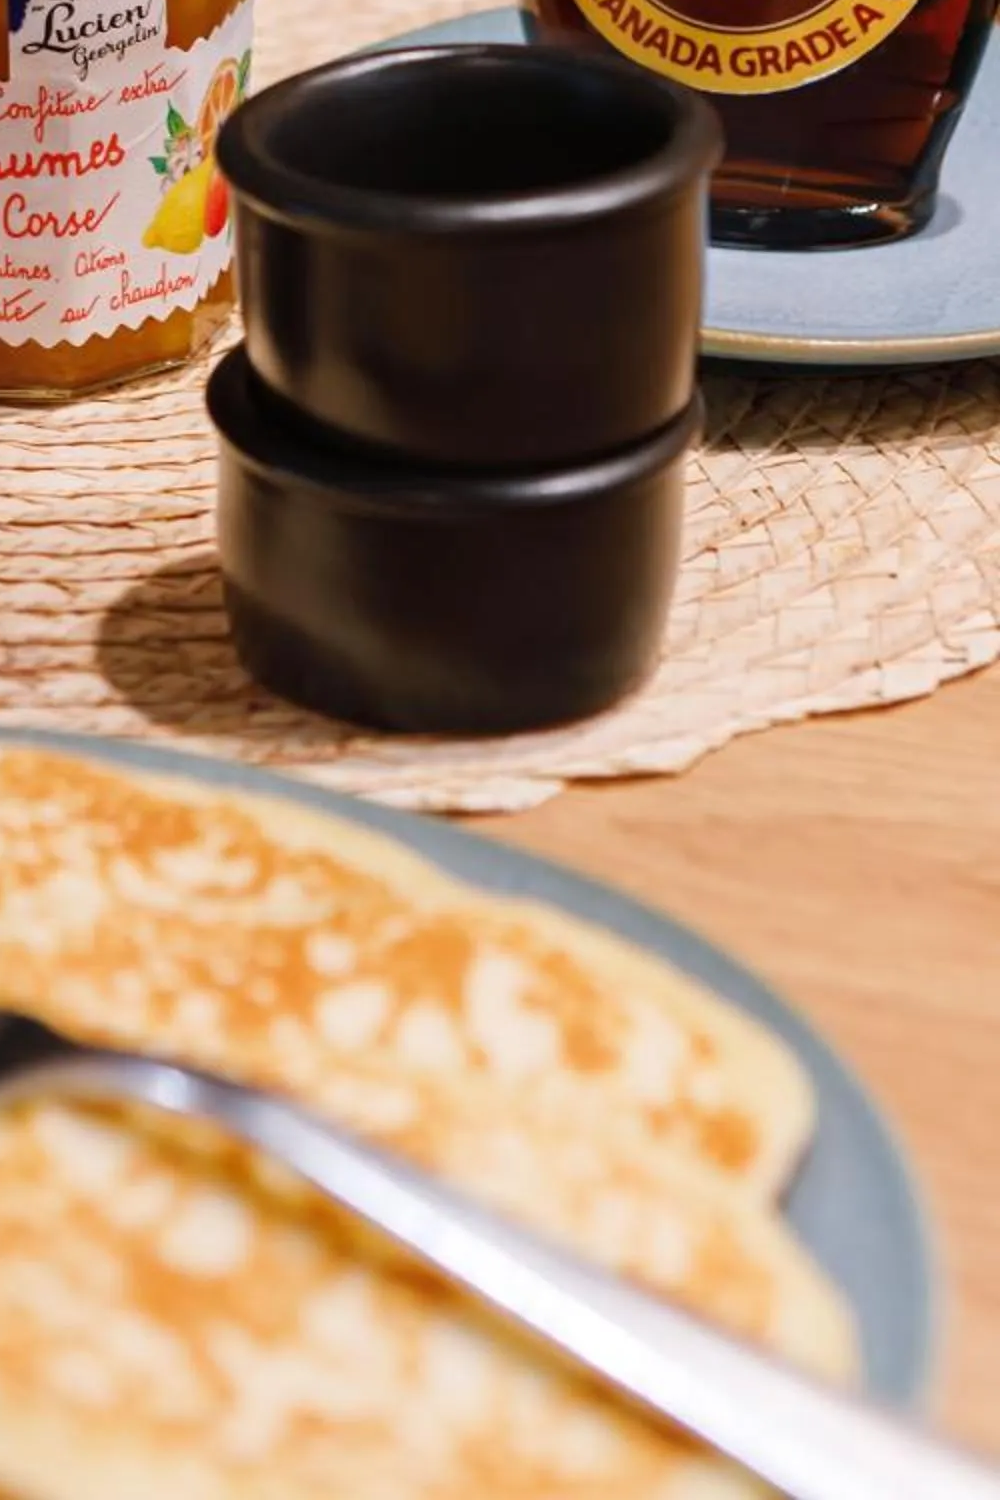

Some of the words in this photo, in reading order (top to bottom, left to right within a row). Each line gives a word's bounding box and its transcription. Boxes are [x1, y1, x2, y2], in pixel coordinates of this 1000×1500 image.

[72, 15, 164, 82] Georgelin
[729, 21, 855, 78] GRADE
[856, 3, 886, 33] A
[118, 61, 188, 106] extra
[2, 192, 121, 240] Corse
[75, 245, 126, 277] Citrons
[61, 295, 100, 323] au
[109, 261, 199, 310] chaudron
